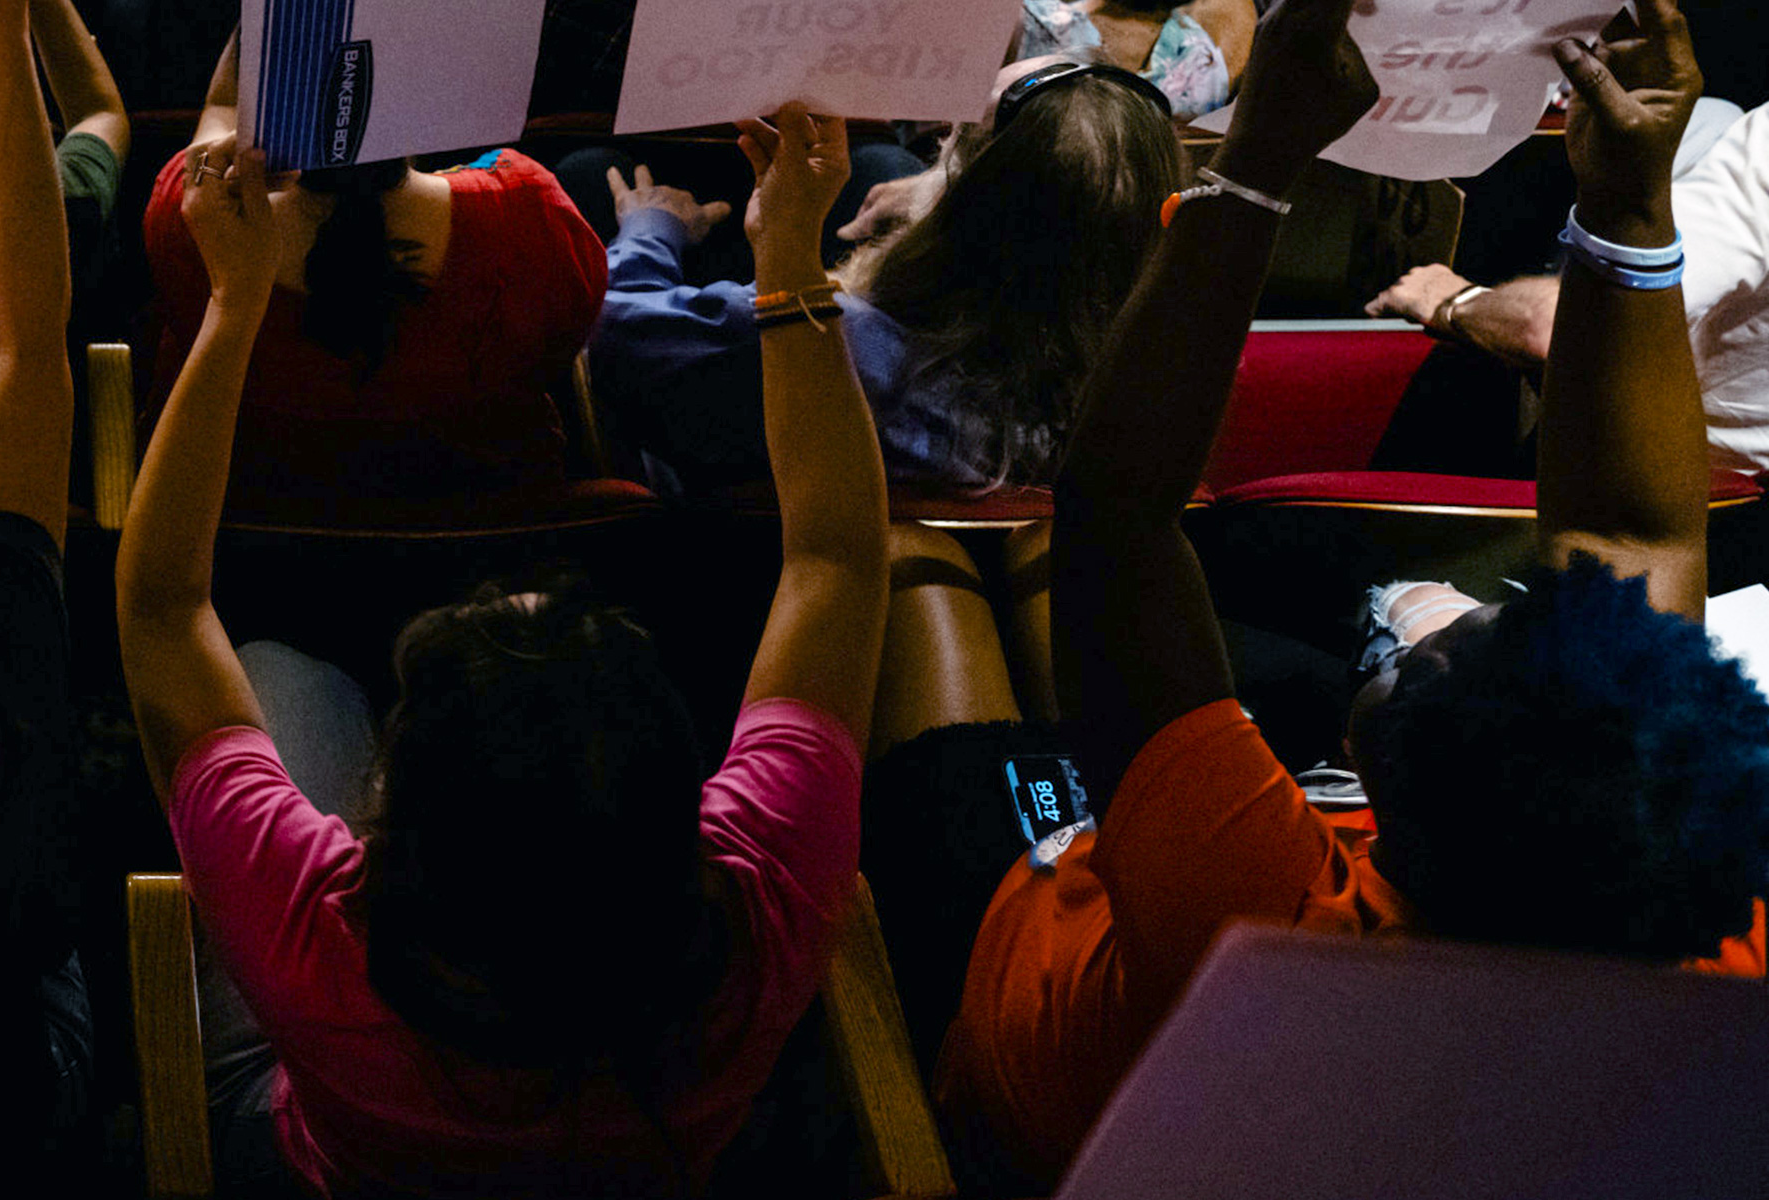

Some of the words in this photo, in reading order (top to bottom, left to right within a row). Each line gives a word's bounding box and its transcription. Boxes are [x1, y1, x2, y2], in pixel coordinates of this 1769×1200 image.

[336, 49, 359, 128] BANKERS
[331, 128, 348, 163] BOX
[1035, 780, 1061, 822] 4:08
